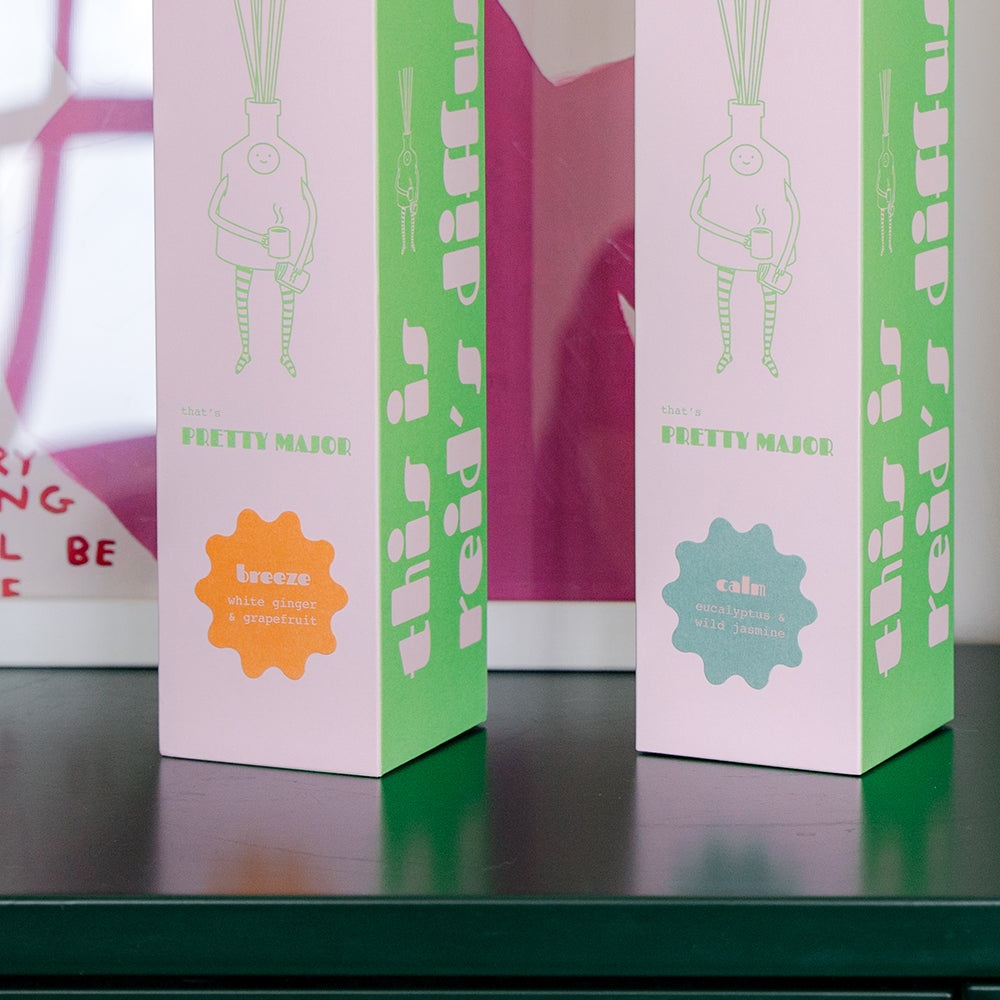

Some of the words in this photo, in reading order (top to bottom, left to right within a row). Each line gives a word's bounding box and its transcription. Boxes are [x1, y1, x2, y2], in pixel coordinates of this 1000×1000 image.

[386, 318, 429, 424] is
[867, 319, 902, 425] is
[181, 406, 221, 417] that's
[661, 405, 701, 416] that's
[181, 426, 268, 450] PRETTY
[275, 432, 351, 456] MAJOR
[661, 425, 749, 450] PRETTY
[756, 432, 834, 456] MAJOR
[443, 339, 483, 649] reid's
[915, 339, 950, 648] reid's
[66, 535, 116, 566] BE
[236, 563, 311, 586] breeze
[387, 455, 431, 679] this
[867, 456, 905, 677] this
[716, 575, 766, 597] calm
[227, 595, 265, 606] white
[272, 598, 317, 611] ginger
[695, 602, 770, 621] eucalyptus
[778, 613, 785, 622] &
[229, 612, 235, 622] &
[243, 614, 317, 626] grapefruit
[695, 618, 725, 631] wild
[733, 623, 785, 638] jasmine
